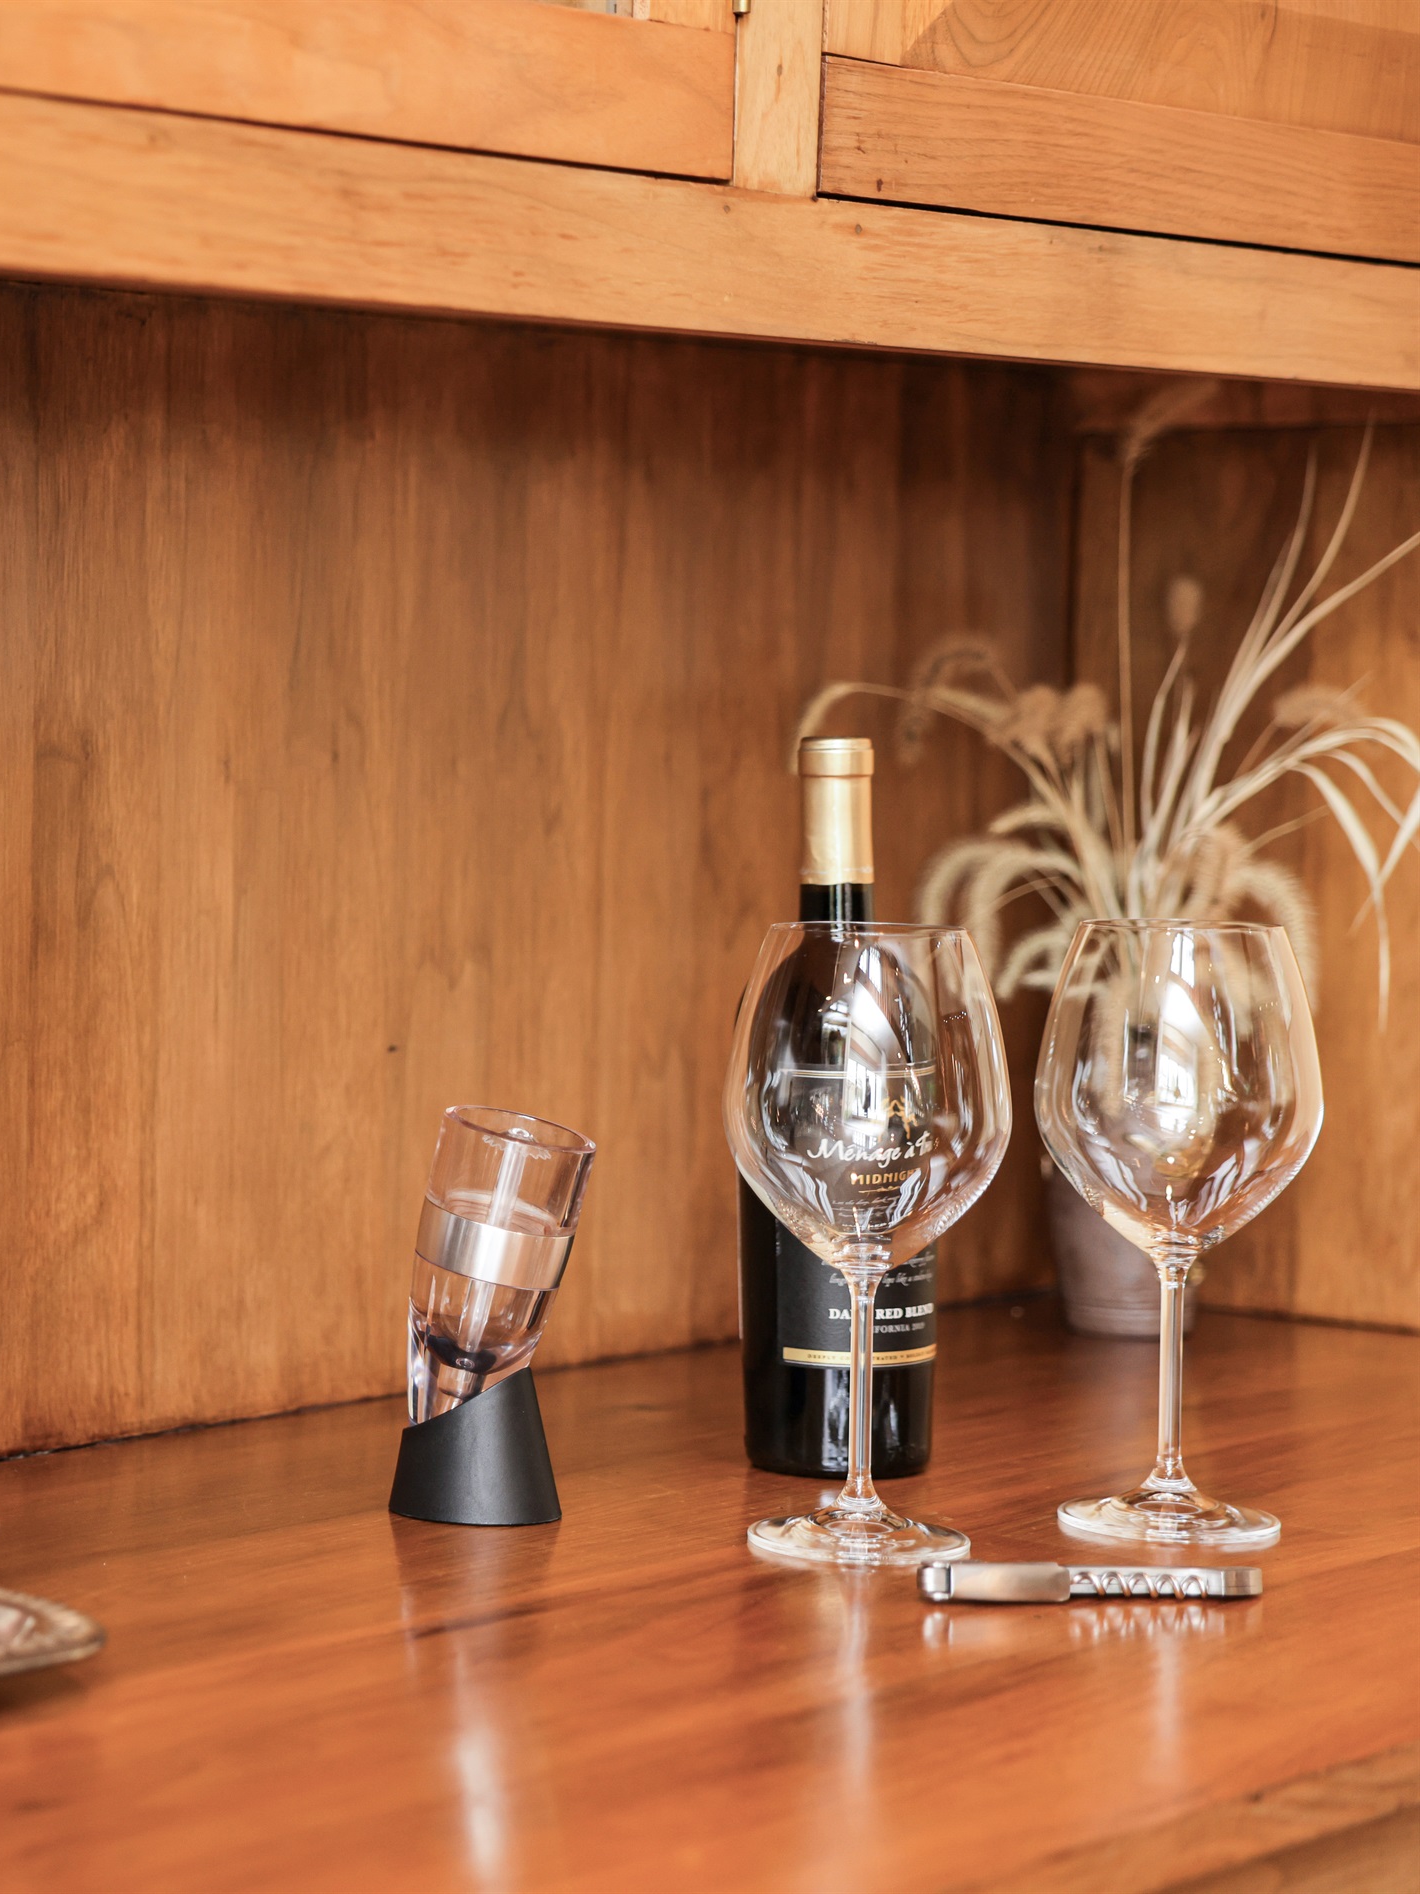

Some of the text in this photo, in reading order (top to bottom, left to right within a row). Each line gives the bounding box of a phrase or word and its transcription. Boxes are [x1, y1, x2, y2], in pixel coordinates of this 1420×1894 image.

[807, 1138, 902, 1168] Ménage
[904, 1142, 916, 1159] à
[874, 1307, 904, 1320] RED
